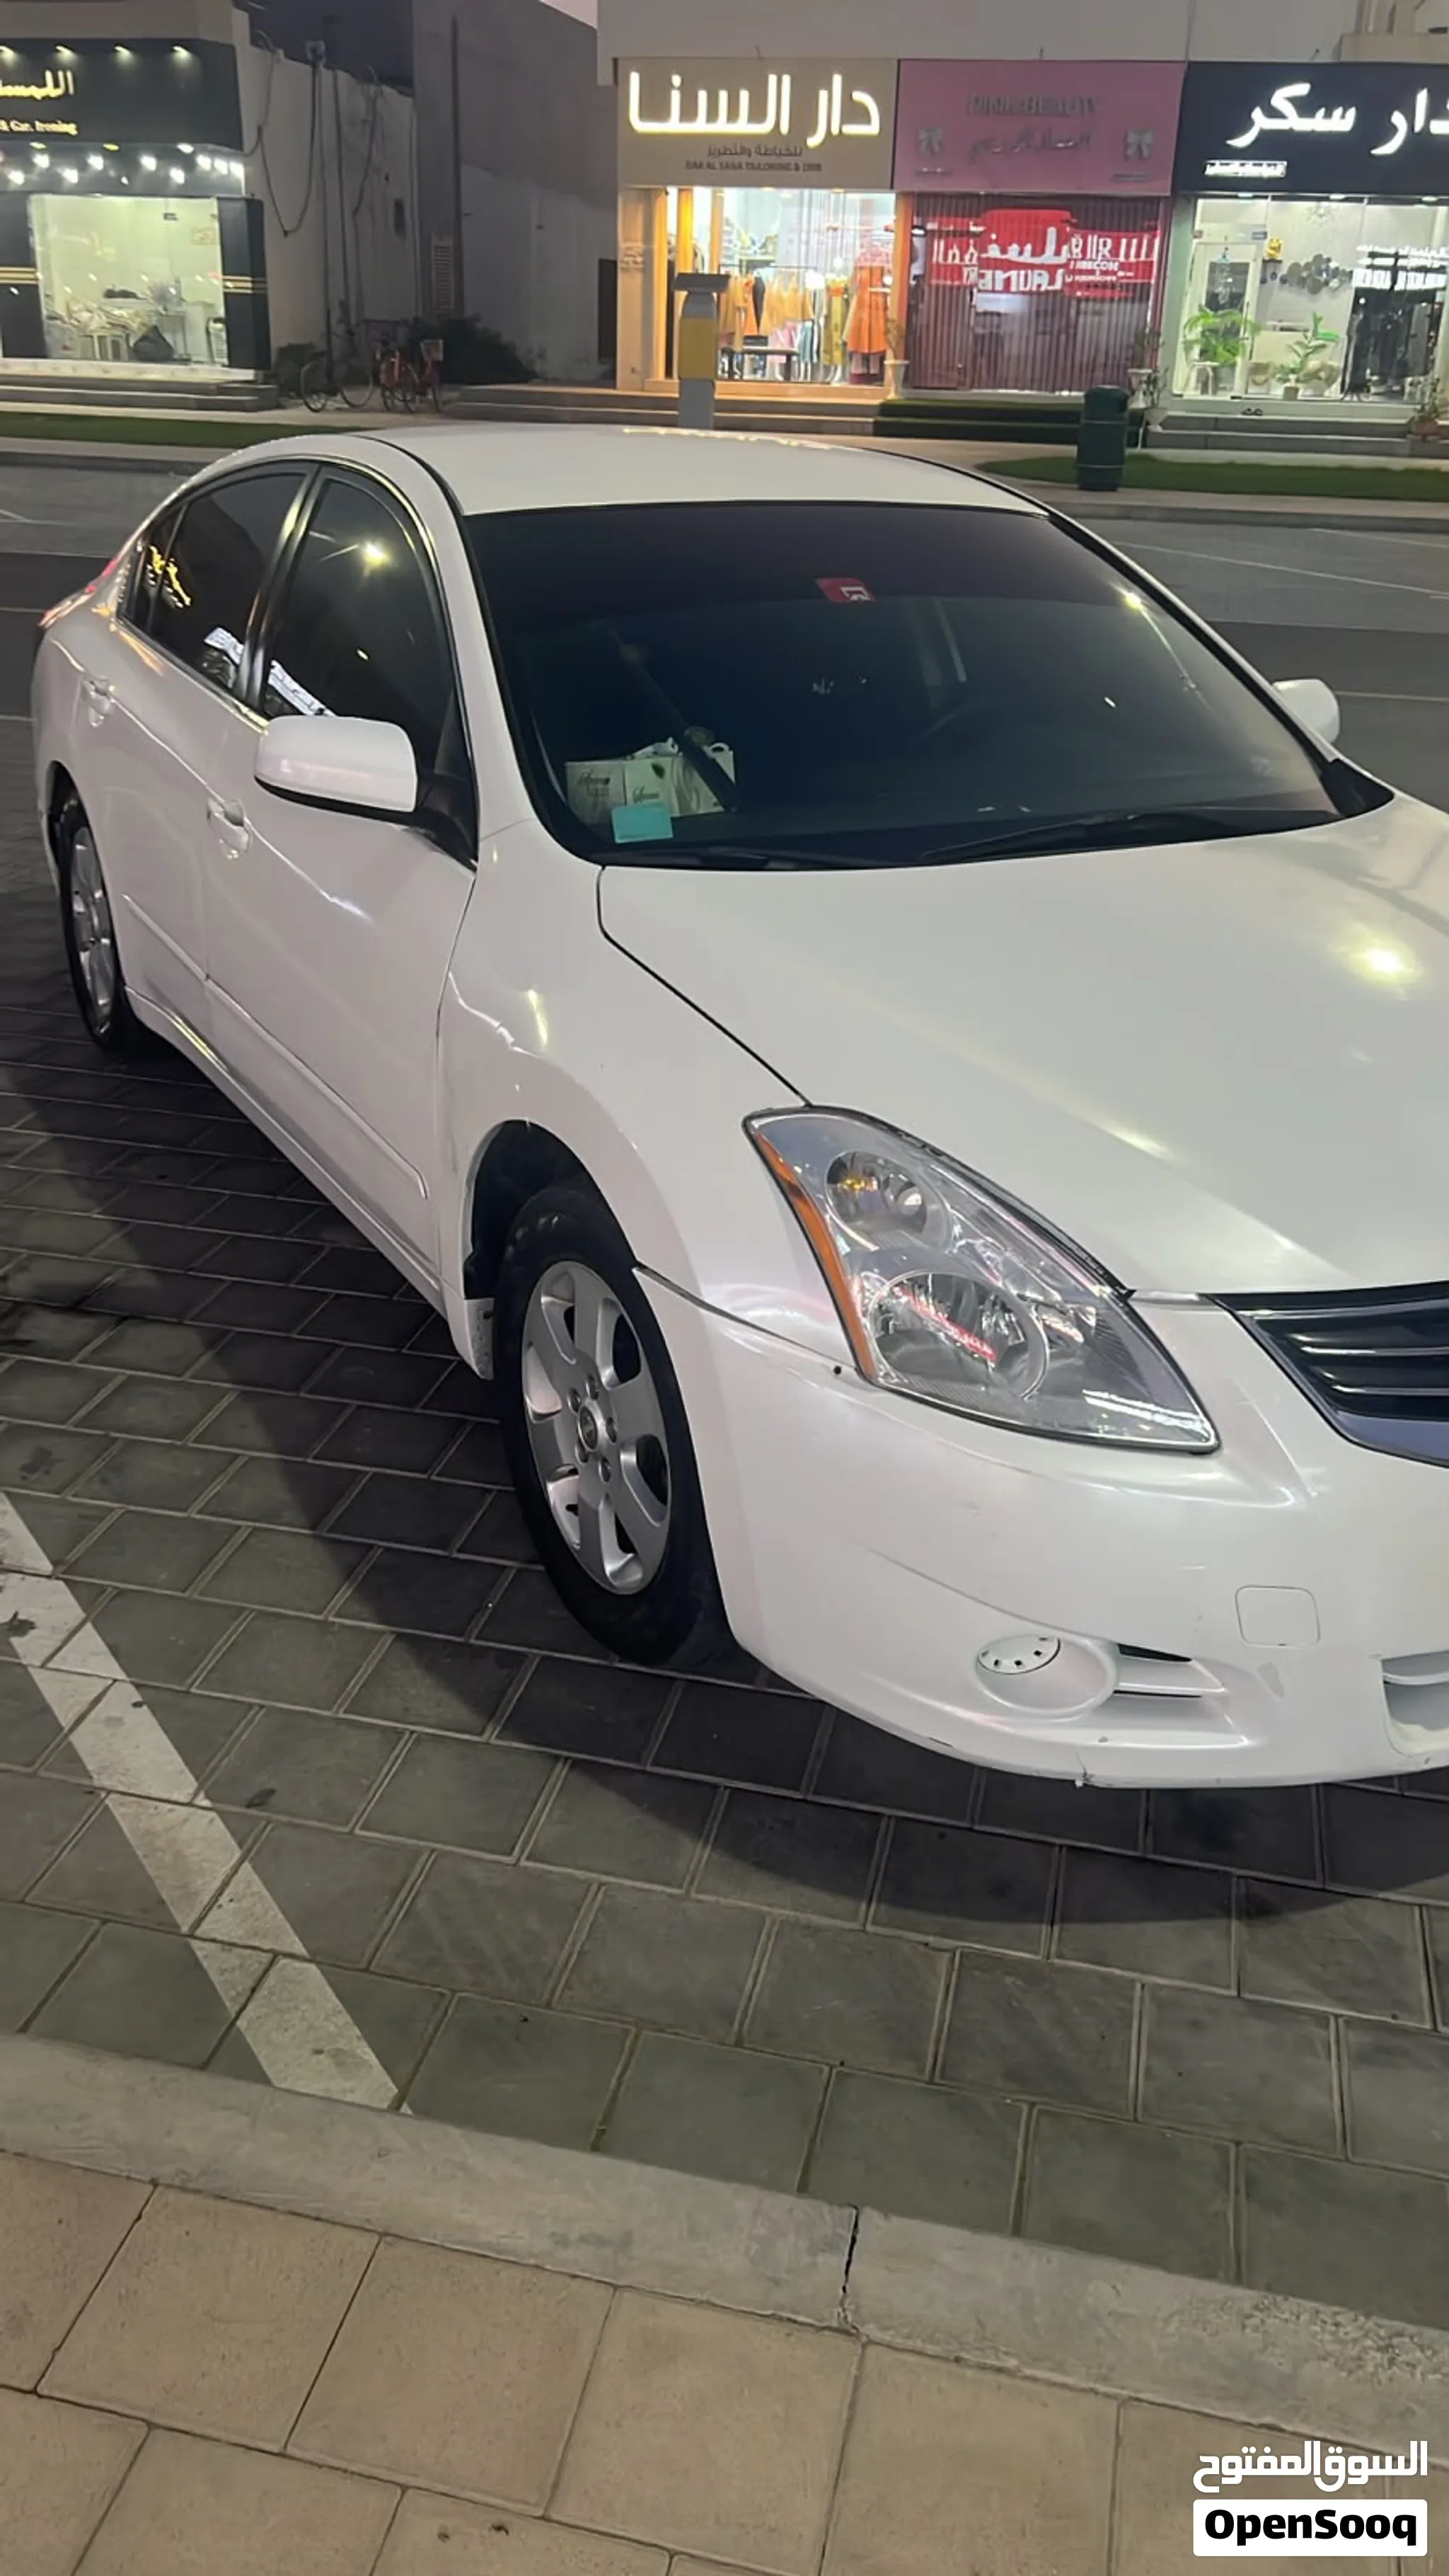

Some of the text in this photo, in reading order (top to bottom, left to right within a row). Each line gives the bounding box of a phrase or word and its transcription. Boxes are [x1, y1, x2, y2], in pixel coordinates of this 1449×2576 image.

[628, 70, 881, 149] دار السنا
[1225, 81, 1357, 149] سكر
